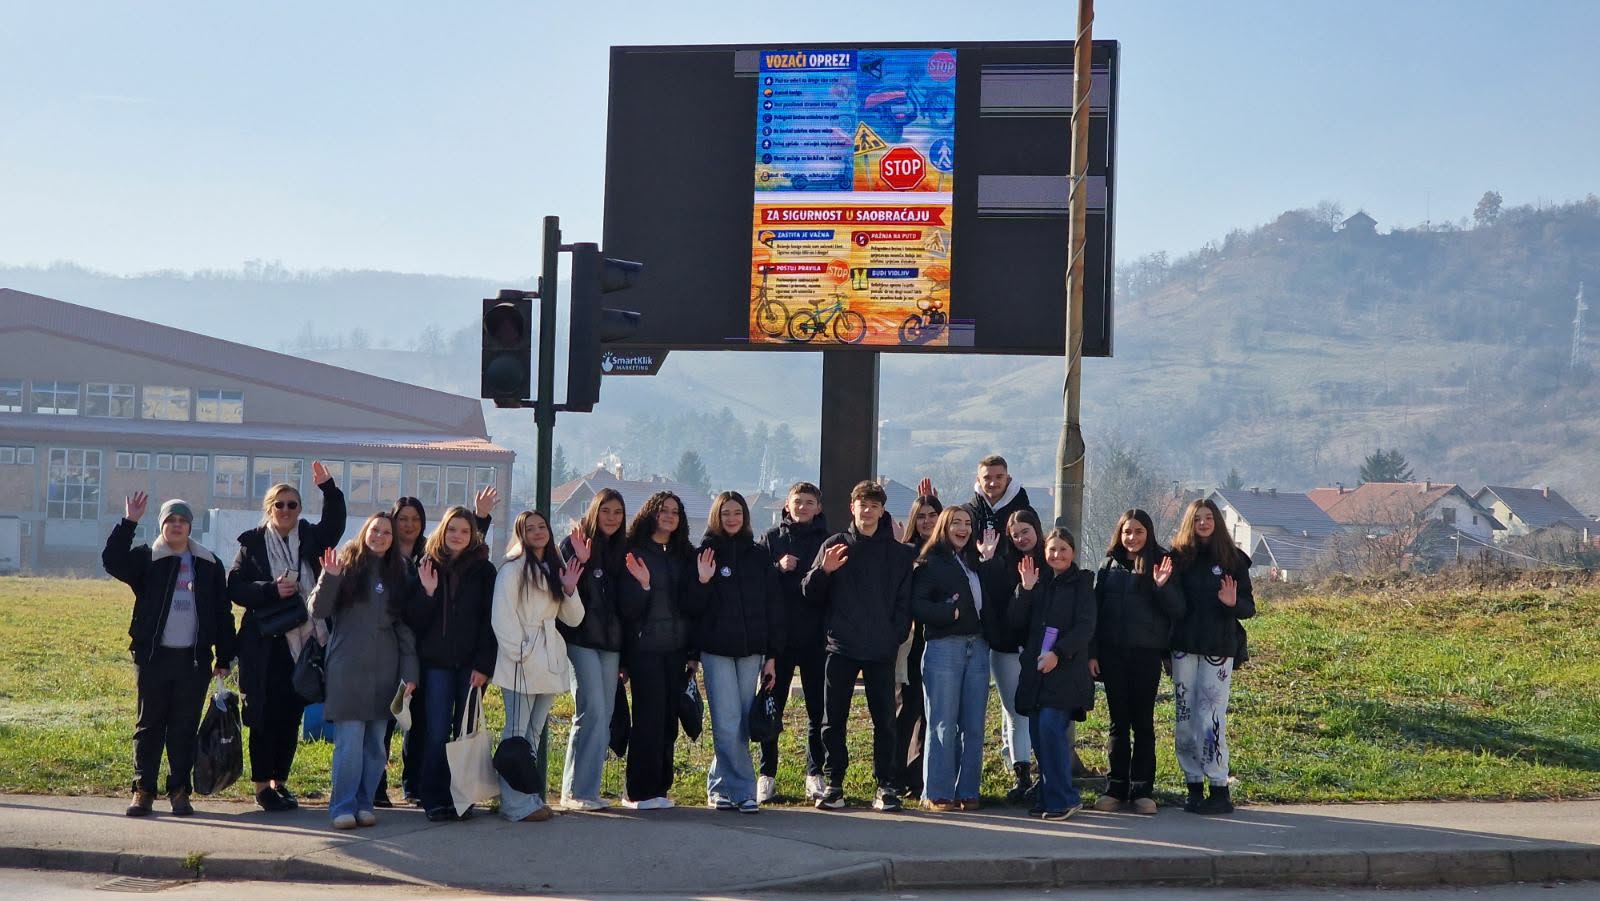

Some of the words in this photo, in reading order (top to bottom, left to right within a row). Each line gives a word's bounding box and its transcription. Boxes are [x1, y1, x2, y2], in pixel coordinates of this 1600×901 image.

[766, 51, 807, 68] VOZAČI
[808, 53, 850, 67] OPREZ!
[929, 59, 954, 73] STOP
[884, 159, 921, 176] STOP
[766, 210, 780, 221] ZA
[782, 209, 843, 221] SIGURNOST
[845, 210, 854, 221] U
[856, 208, 930, 221] SAOBRAĆAJU
[828, 266, 849, 279] STOP
[612, 356, 653, 364] SmartKlik
